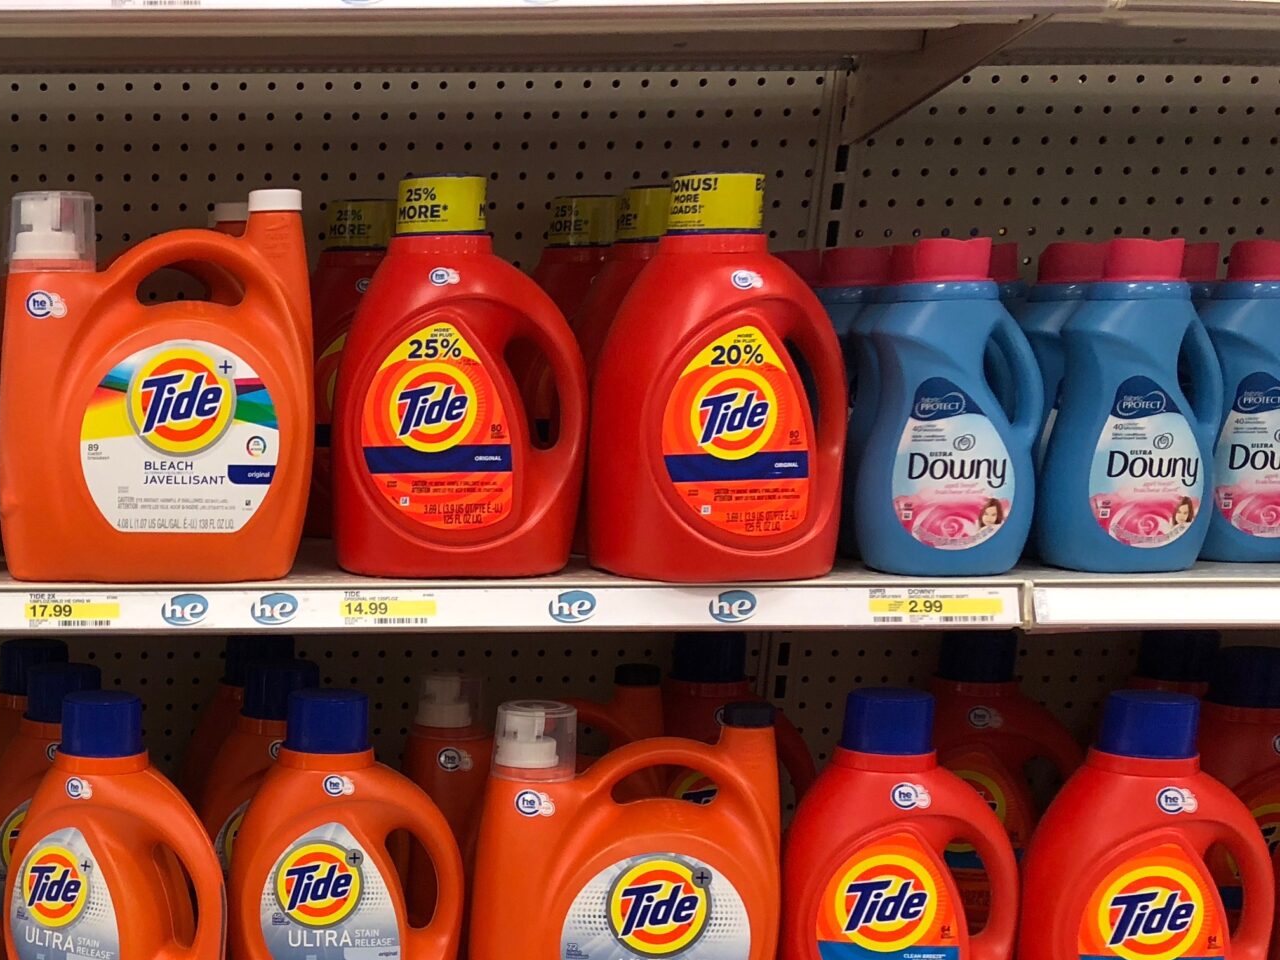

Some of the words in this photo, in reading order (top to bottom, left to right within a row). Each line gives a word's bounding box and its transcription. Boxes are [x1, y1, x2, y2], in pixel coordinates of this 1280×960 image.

[406, 188, 436, 202] 25%
[674, 194, 699, 203] MORE
[408, 339, 461, 359] 25%
[710, 345, 763, 365] 20%
[140, 374, 222, 435] Tide
[397, 386, 467, 437] Tide
[920, 402, 960, 411] PROTECT
[1122, 400, 1161, 409] PROTECT
[699, 391, 768, 445] Tide
[88, 444, 99, 452] 89
[144, 461, 193, 471] BLEACH
[247, 471, 270, 479] original
[908, 452, 1006, 488] Downy
[1107, 450, 1199, 487] Downy
[143, 475, 225, 485] JAVELLISANT
[30, 605, 72, 617] 17.99
[164, 596, 206, 624] he
[253, 595, 295, 623] he
[345, 603, 388, 615] 14.99
[552, 594, 595, 621] he
[712, 594, 754, 621] he
[909, 601, 942, 613] 2.99
[27, 866, 81, 906] Tide
[286, 863, 352, 912] Tide
[619, 883, 698, 938] Tide
[842, 879, 927, 933] Tide
[1106, 891, 1195, 947] Tide
[26, 927, 74, 952] ULTRA
[77, 937, 99, 948] STAIN
[288, 930, 351, 947] ULTRA
[355, 929, 379, 937] STAIN
